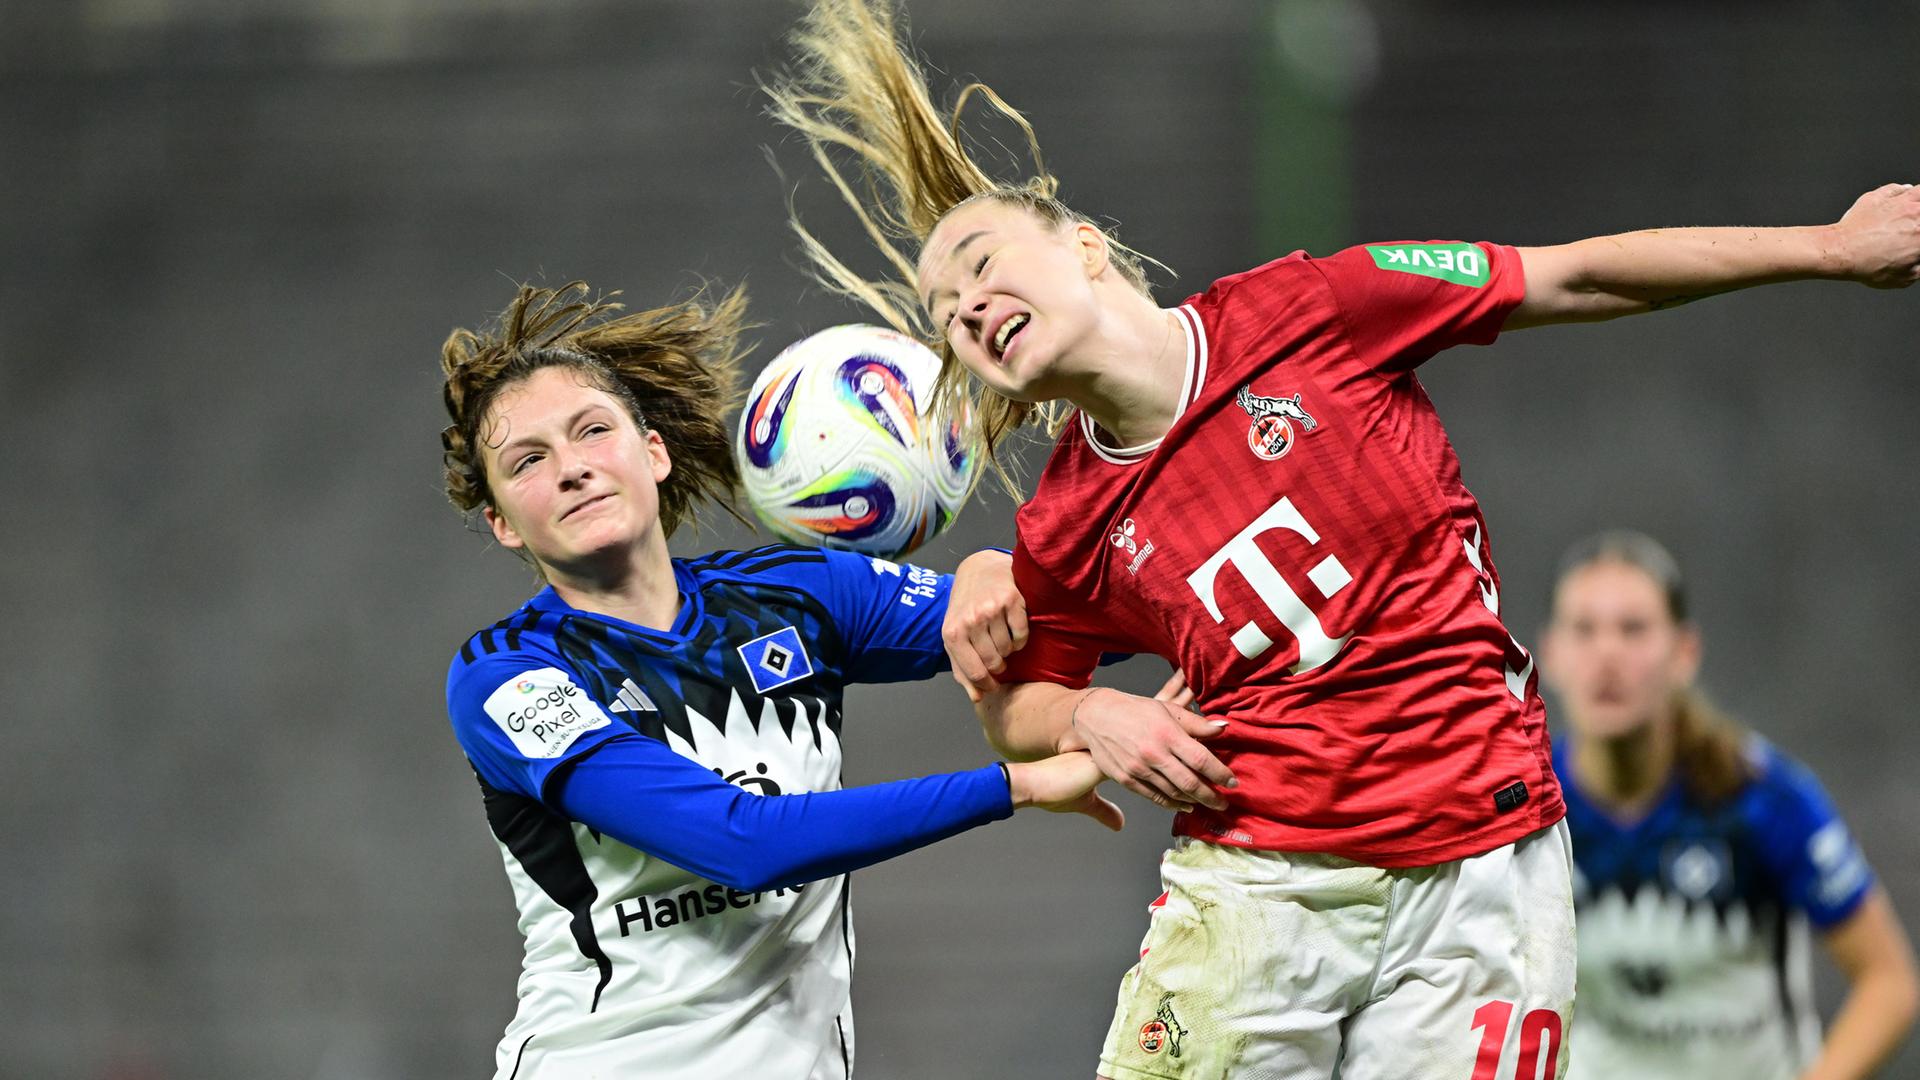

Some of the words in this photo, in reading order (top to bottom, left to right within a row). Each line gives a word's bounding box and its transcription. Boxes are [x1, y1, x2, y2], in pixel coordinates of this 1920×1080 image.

[1379, 249, 1479, 277] DEVK
[1126, 539, 1154, 576] hummel
[1186, 496, 1355, 676] T
[507, 684, 577, 733] Google
[532, 703, 581, 743] Pixel
[615, 883, 805, 938] Hanse
[1471, 1000, 1562, 1080] 10
